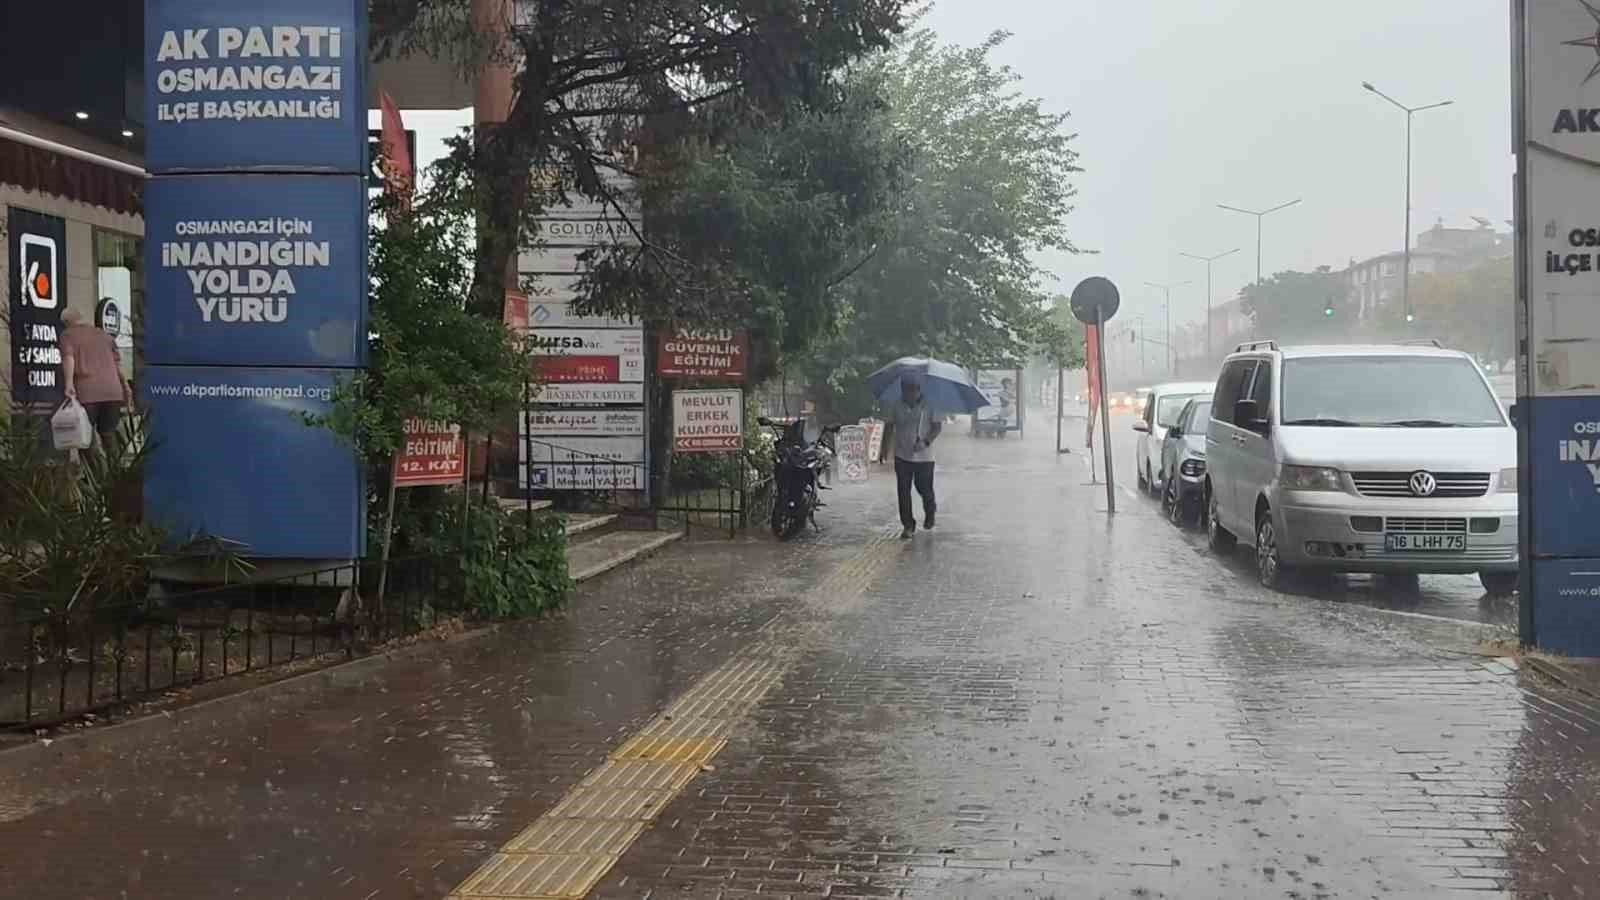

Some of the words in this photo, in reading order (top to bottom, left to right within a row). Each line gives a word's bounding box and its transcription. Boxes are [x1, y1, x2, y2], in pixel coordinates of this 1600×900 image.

[157, 29, 209, 61] AK
[218, 26, 341, 59] PARTİ
[157, 65, 341, 93] OSMANGAZİ
[158, 103, 199, 123] İLÇE
[203, 96, 341, 121] BAŞKANLIĞI
[1552, 109, 1600, 133] AK
[176, 218, 274, 235] OSMANGAZİ
[277, 217, 313, 238] İÇİN
[162, 238, 330, 267] İNANDIĞIN
[1546, 250, 1592, 276] İLÇE
[187, 269, 296, 294] YOLDA
[196, 297, 288, 322] YÜRÜ
[32, 323, 57, 341] AYDA
[664, 340, 741, 355] GÜVENLİK
[673, 353, 731, 368] EĞİTİMİ
[28, 370, 56, 387] OLUN
[150, 383, 331, 401] www.akpartiosmangazi.org
[688, 410, 729, 421] ERKEK
[406, 438, 457, 456] EĞİTİMİ
[401, 461, 424, 471] 12.
[428, 460, 460, 471] KAT
[1394, 535, 1407, 548] 16
[1413, 535, 1442, 548] LHH
[1446, 535, 1463, 548] 75
